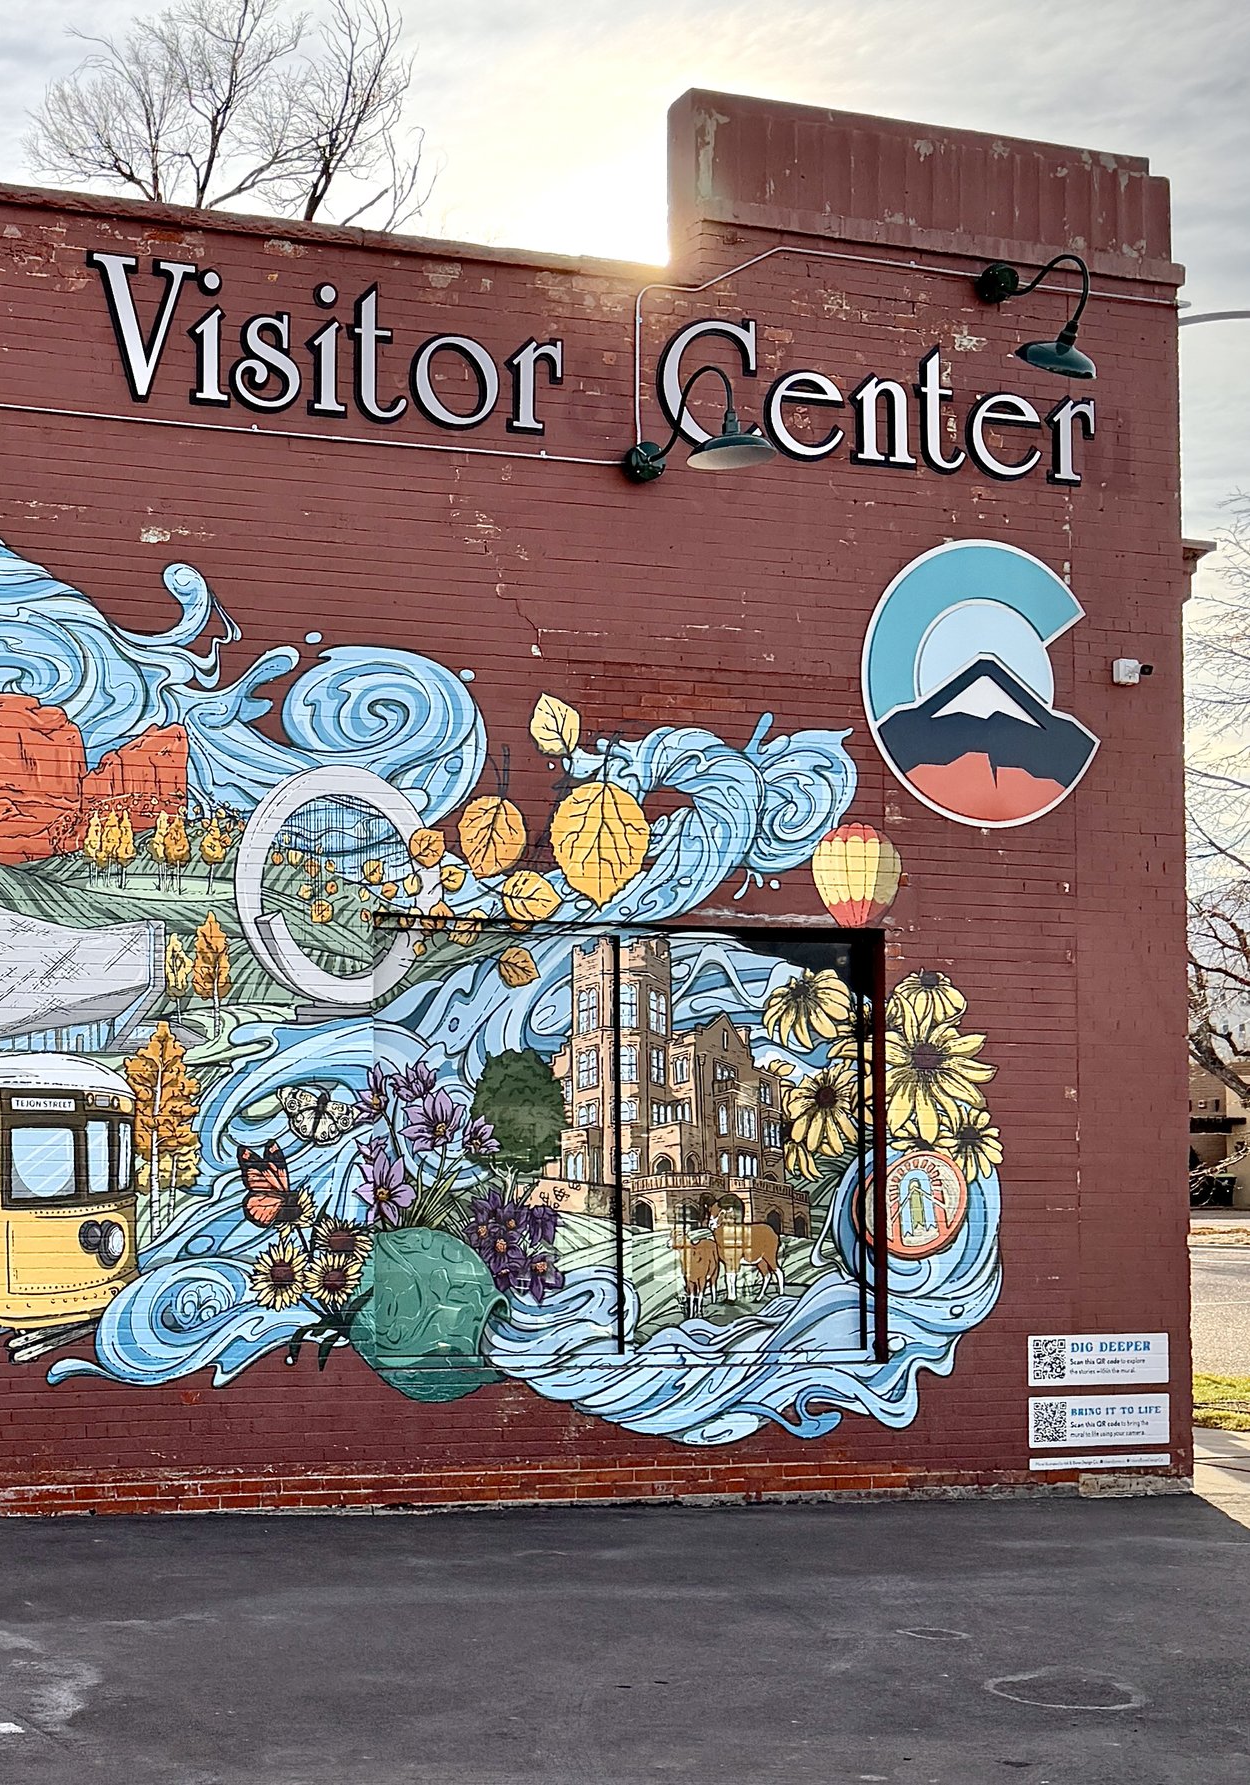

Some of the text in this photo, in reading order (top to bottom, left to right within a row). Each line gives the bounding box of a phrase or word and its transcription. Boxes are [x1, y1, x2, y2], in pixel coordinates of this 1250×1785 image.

[86, 250, 1096, 487] Visitor Center
[15, 1099, 72, 1108] TEJON STREET
[1070, 1340, 1151, 1353] DIG DEEPER
[1069, 1358, 1084, 1366] Scan
[1084, 1357, 1095, 1365] this
[1096, 1357, 1106, 1365] QR
[1127, 1356, 1146, 1365] explore
[1078, 1367, 1096, 1375] stories
[1070, 1405, 1162, 1416] BRING IT TO LIFE
[1070, 1421, 1084, 1429] Scan
[1085, 1420, 1096, 1428] this
[1096, 1420, 1106, 1428] QR
[1127, 1420, 1141, 1428] bring
